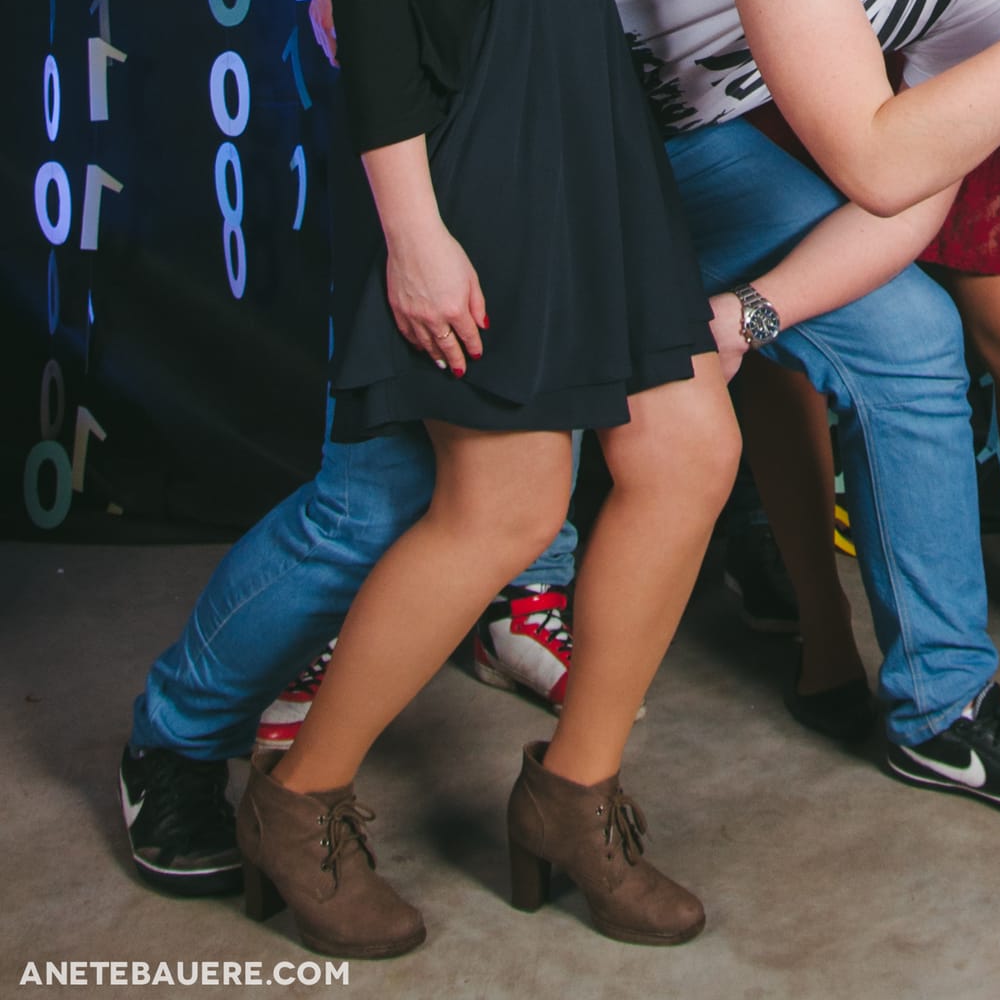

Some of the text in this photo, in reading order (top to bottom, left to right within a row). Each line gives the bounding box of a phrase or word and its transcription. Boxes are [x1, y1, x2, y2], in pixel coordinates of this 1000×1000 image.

[44, 55, 60, 141] 0
[210, 51, 250, 136] 0
[34, 161, 71, 245] 0
[215, 142, 243, 228] 0
[291, 145, 306, 230] 1
[223, 222, 247, 299] 0
[24, 440, 72, 529] 0
